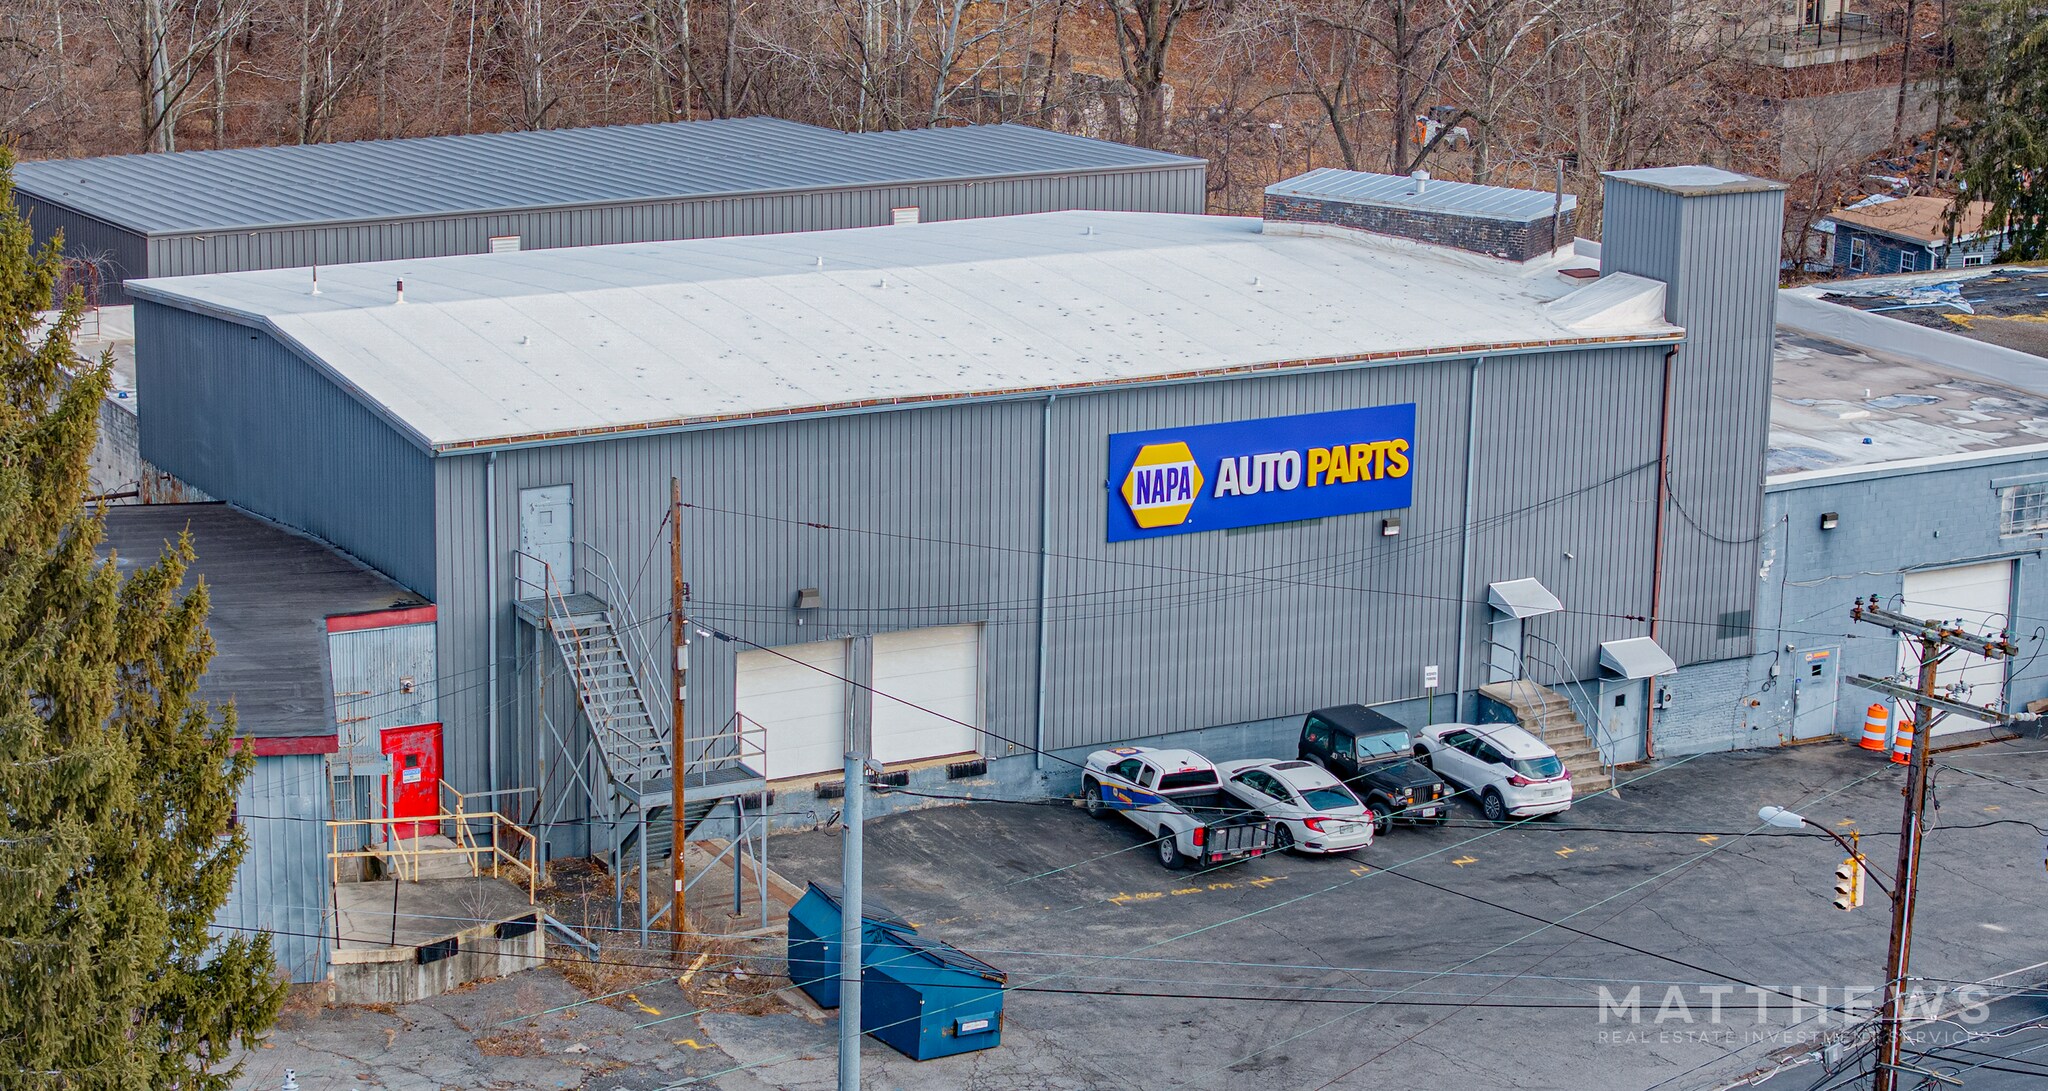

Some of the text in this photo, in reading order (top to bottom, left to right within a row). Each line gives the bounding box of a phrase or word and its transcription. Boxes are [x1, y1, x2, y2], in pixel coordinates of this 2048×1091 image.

[1136, 438, 1410, 505] NAPA AUTO PARTS
